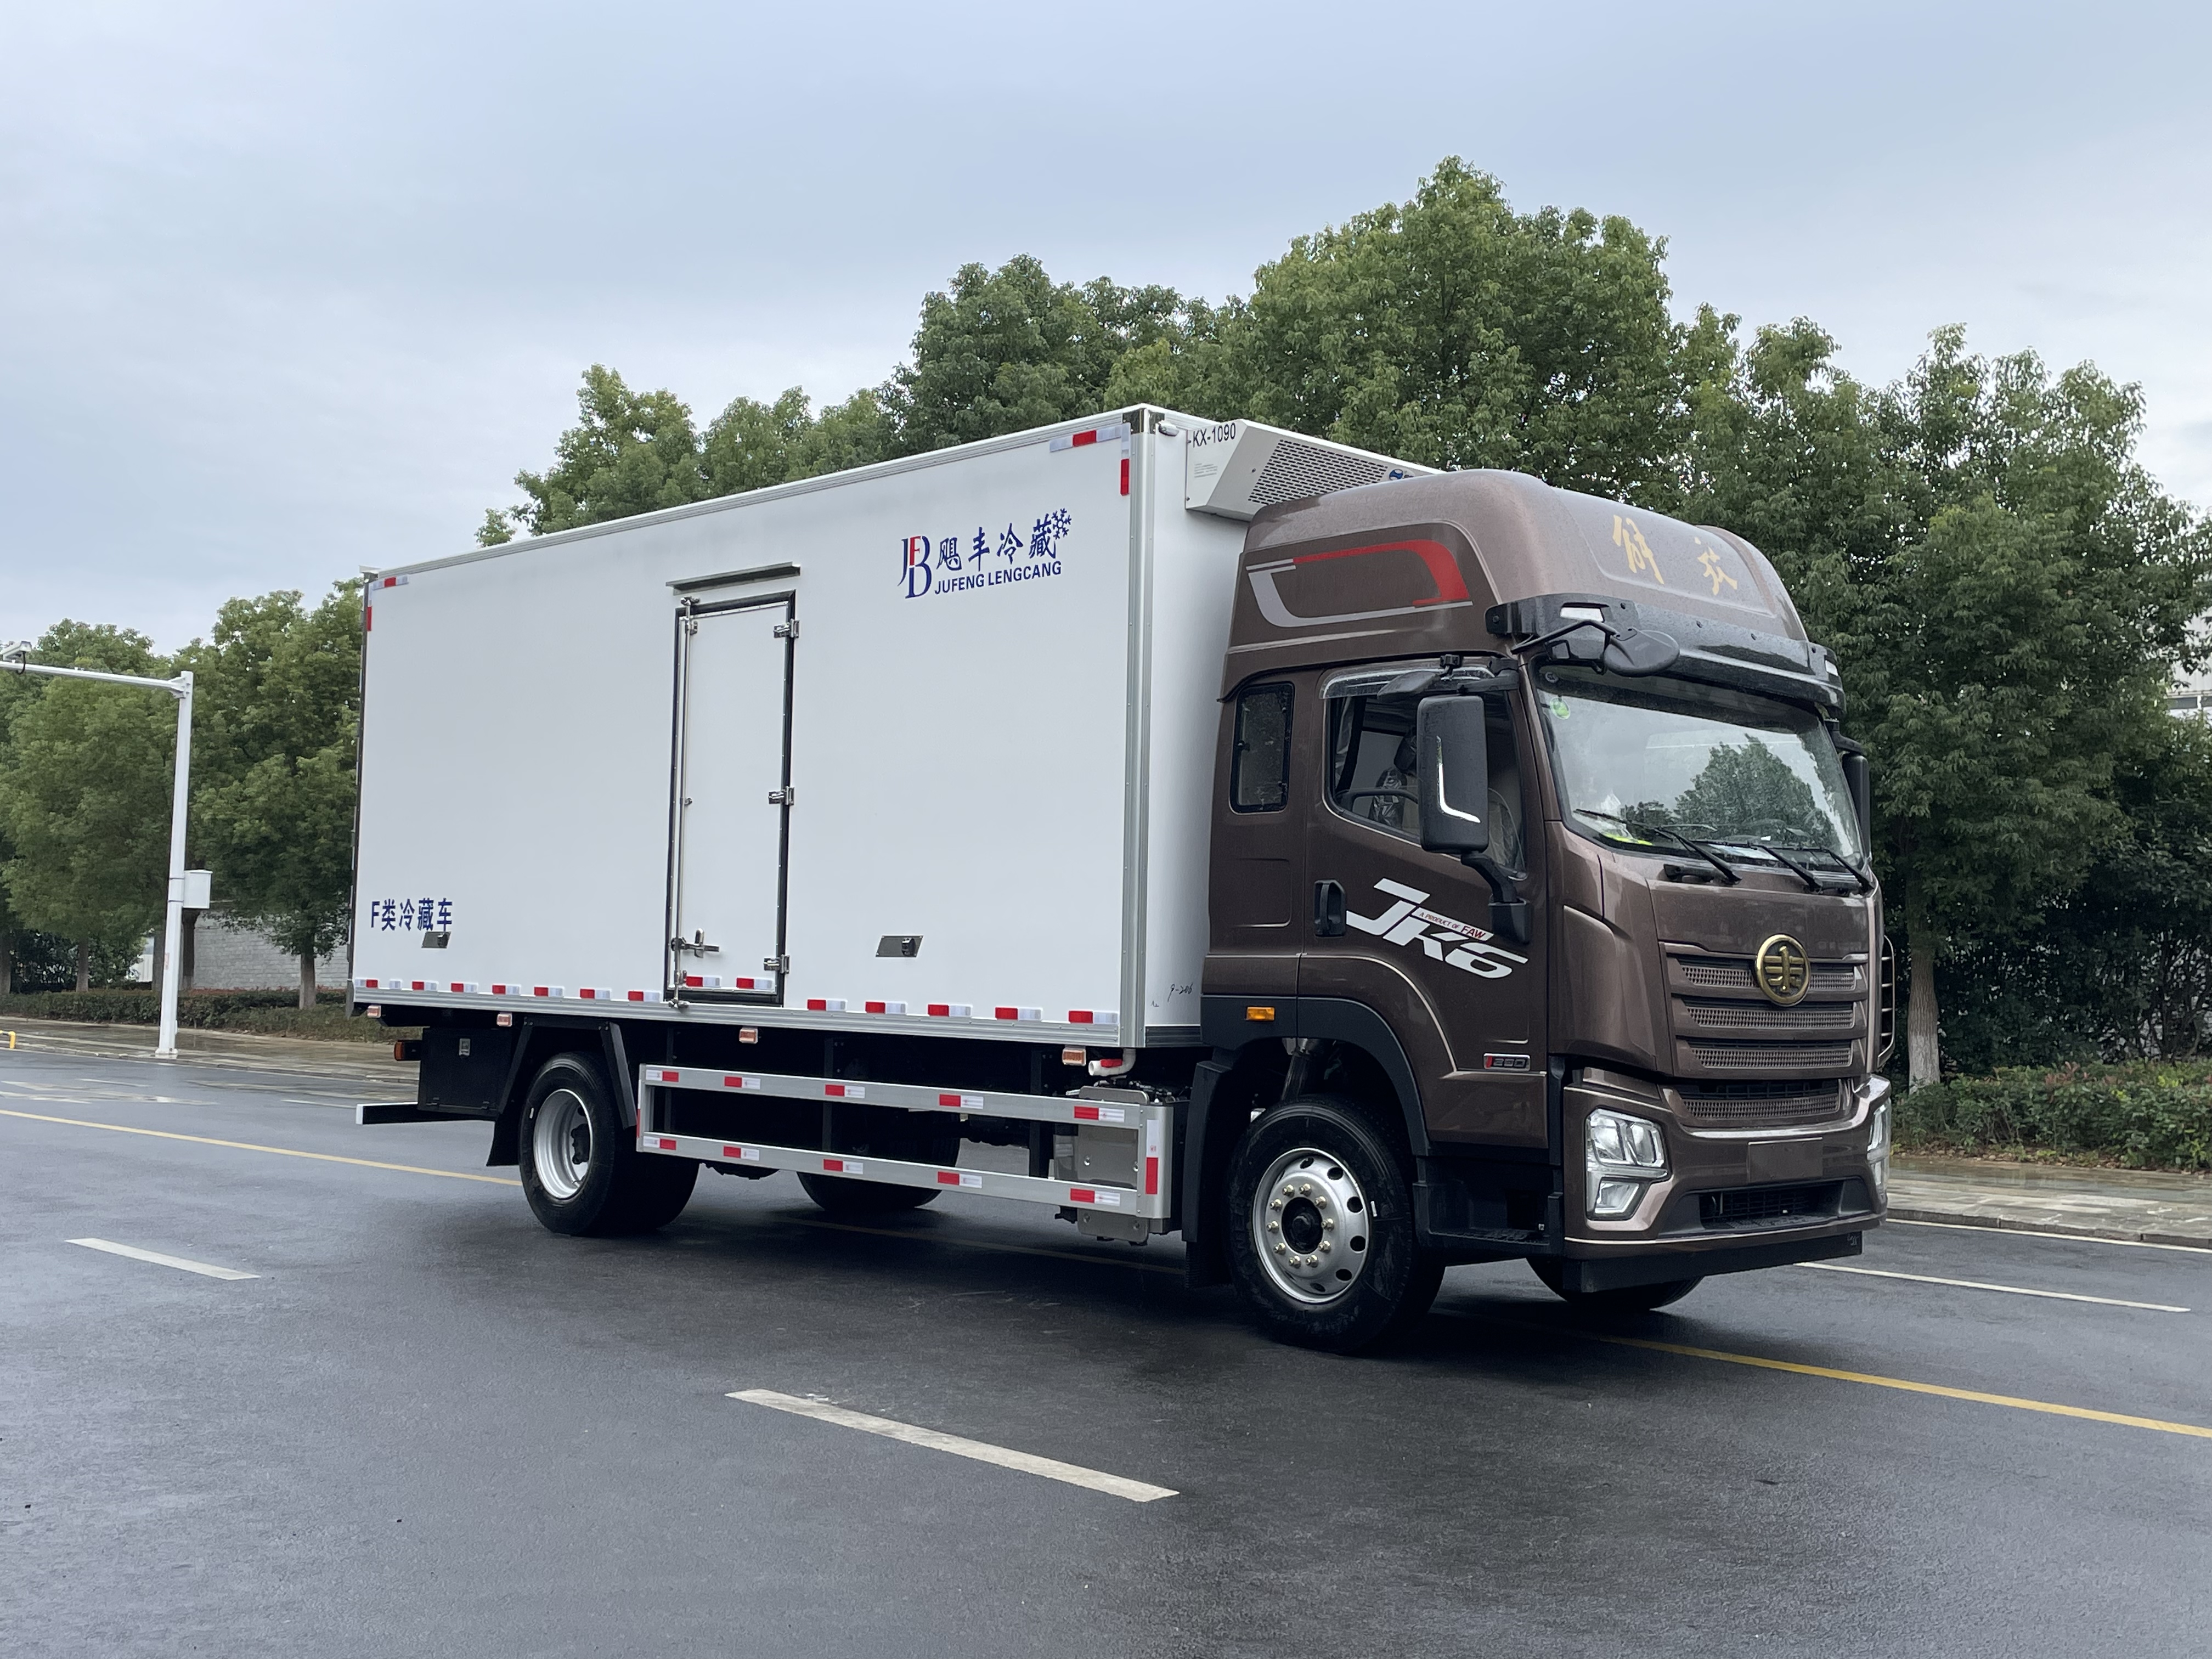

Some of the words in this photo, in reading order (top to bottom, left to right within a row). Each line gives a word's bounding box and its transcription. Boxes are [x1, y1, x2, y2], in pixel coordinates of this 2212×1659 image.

[1193, 422, 1236, 448] KX-1090
[934, 573, 985, 595] JUFENG
[988, 561, 1062, 586] LENGCANG
[370, 898, 453, 932] F类冷藏车
[1346, 878, 1528, 979] JK6
[1425, 913, 1452, 927] PRODUCT
[1460, 926, 1486, 939] FAW
